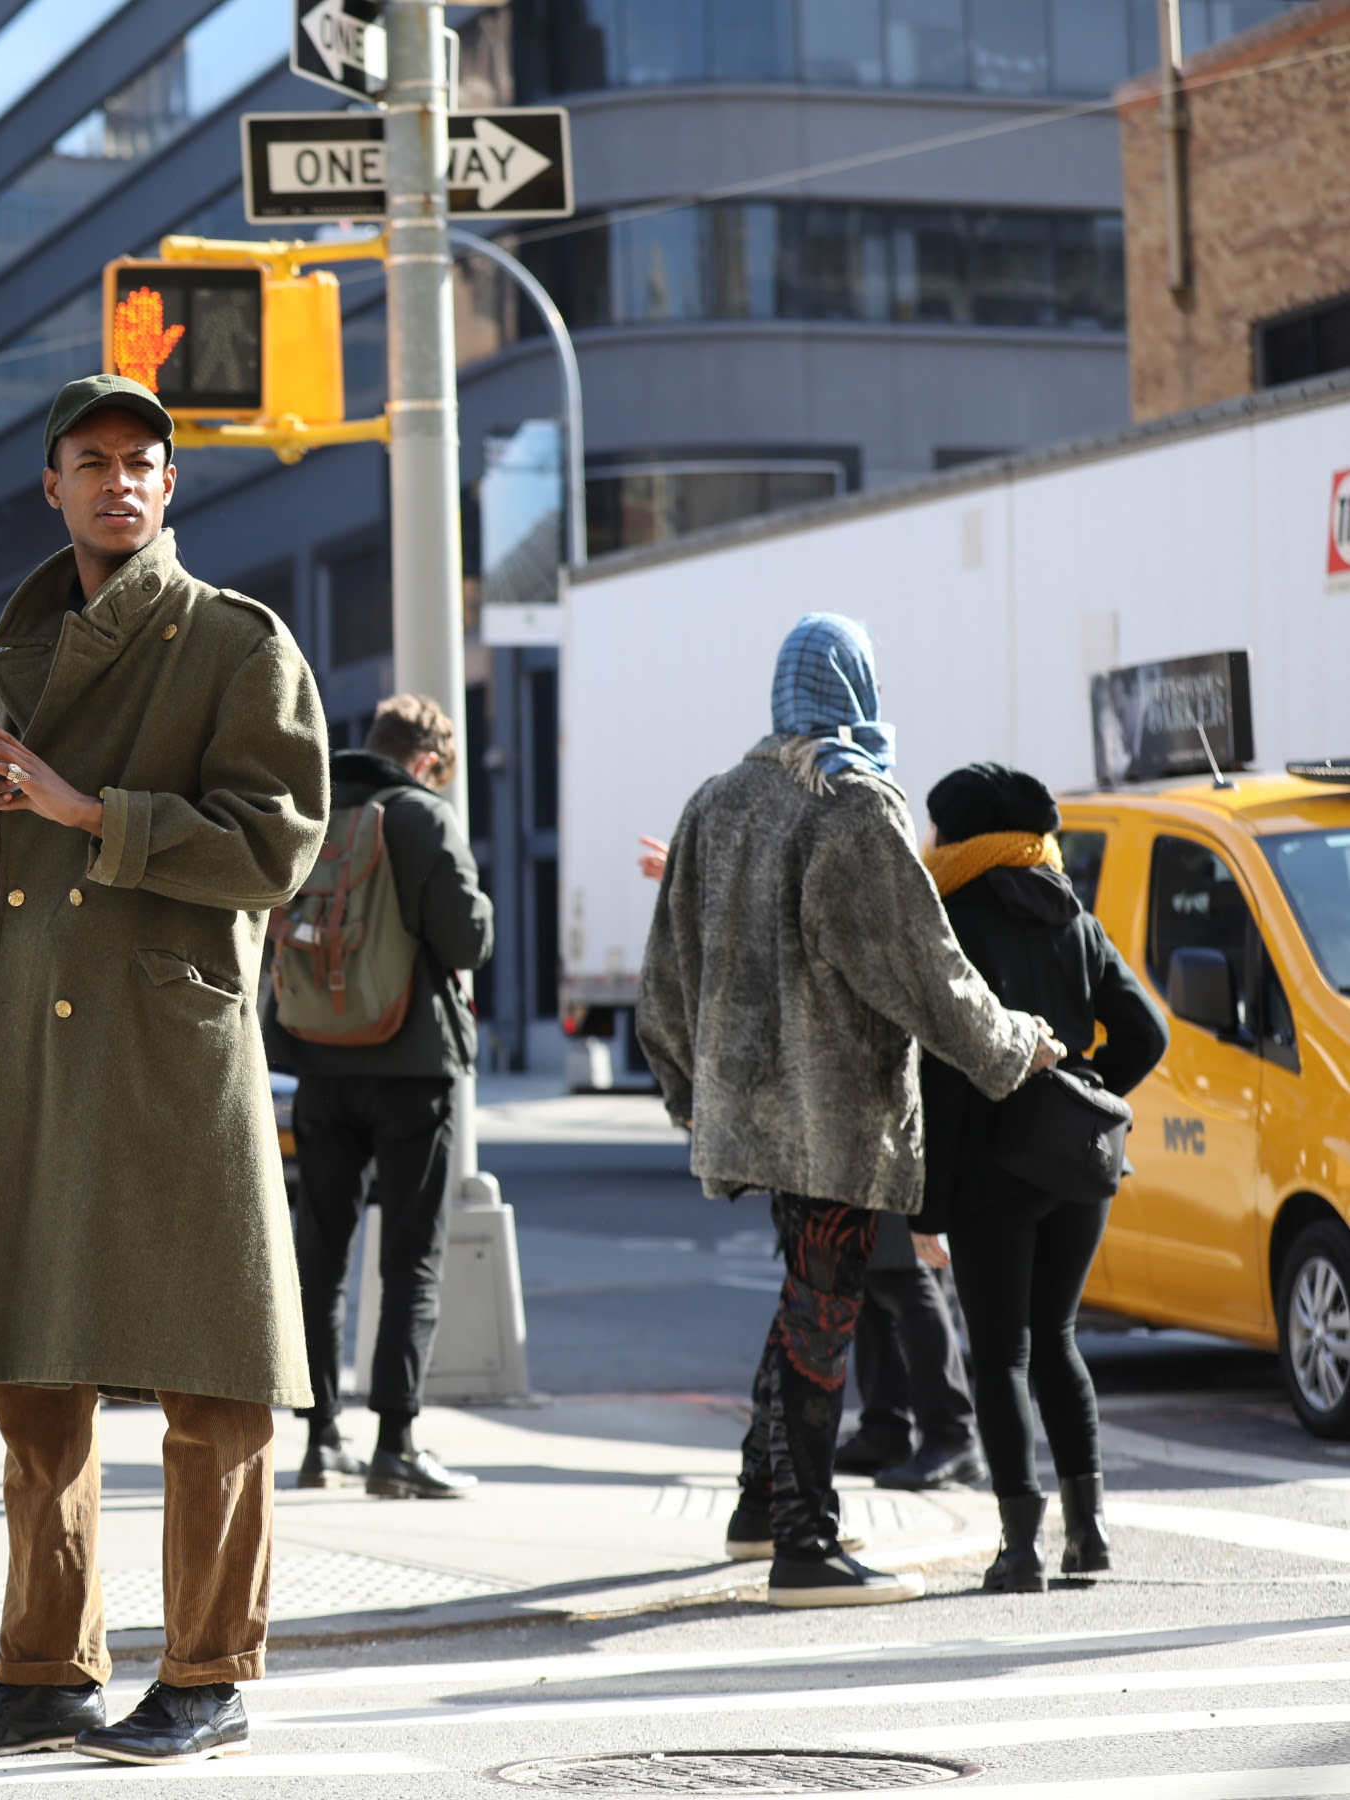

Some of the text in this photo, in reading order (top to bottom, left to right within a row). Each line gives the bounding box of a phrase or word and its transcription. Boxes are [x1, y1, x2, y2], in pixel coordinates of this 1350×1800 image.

[319, 12, 365, 62] ONE
[295, 147, 384, 186] ONE
[1163, 1116, 1206, 1156] NYC
